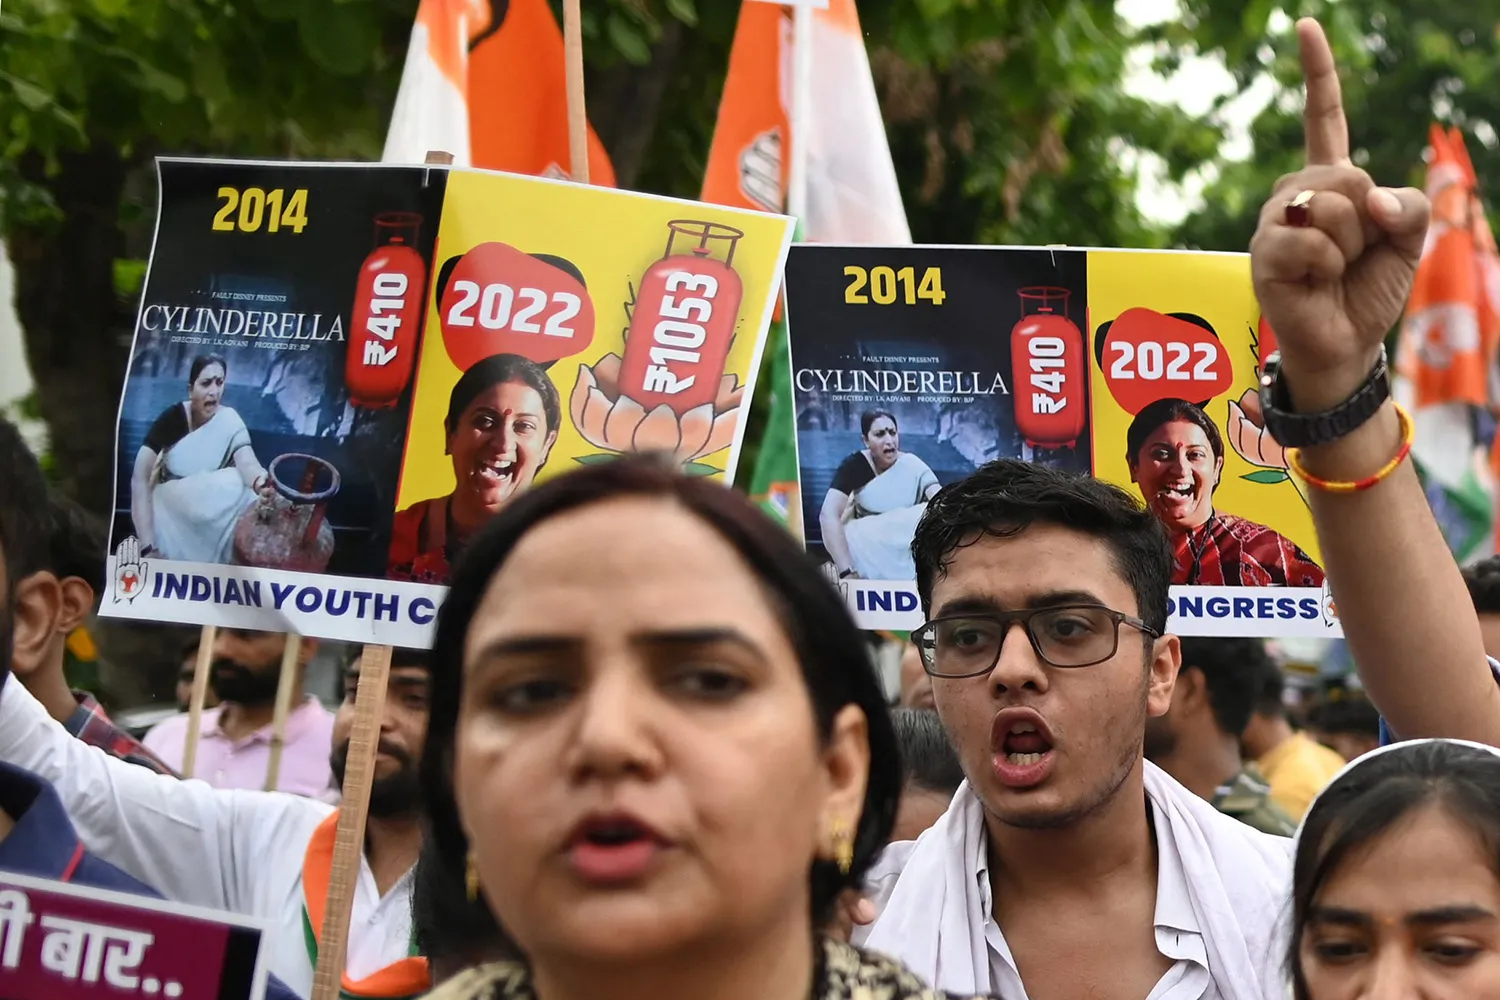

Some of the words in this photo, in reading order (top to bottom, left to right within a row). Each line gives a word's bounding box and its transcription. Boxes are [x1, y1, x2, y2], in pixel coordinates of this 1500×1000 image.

[212, 186, 309, 235] 2014
[446, 279, 582, 340] 2022
[844, 265, 946, 306] 2014
[141, 304, 346, 342] CYLINDERELLA
[363, 271, 408, 366] ₹410
[641, 267, 720, 396] ₹1053
[795, 368, 1010, 395] CYLINDERELLA
[1027, 336, 1067, 414] ₹410
[1109, 340, 1219, 381] 2022
[152, 571, 262, 605] INDIAN
[270, 582, 400, 622] YOUTH
[857, 590, 918, 612] IND
[1166, 596, 1319, 619] NGRESS
